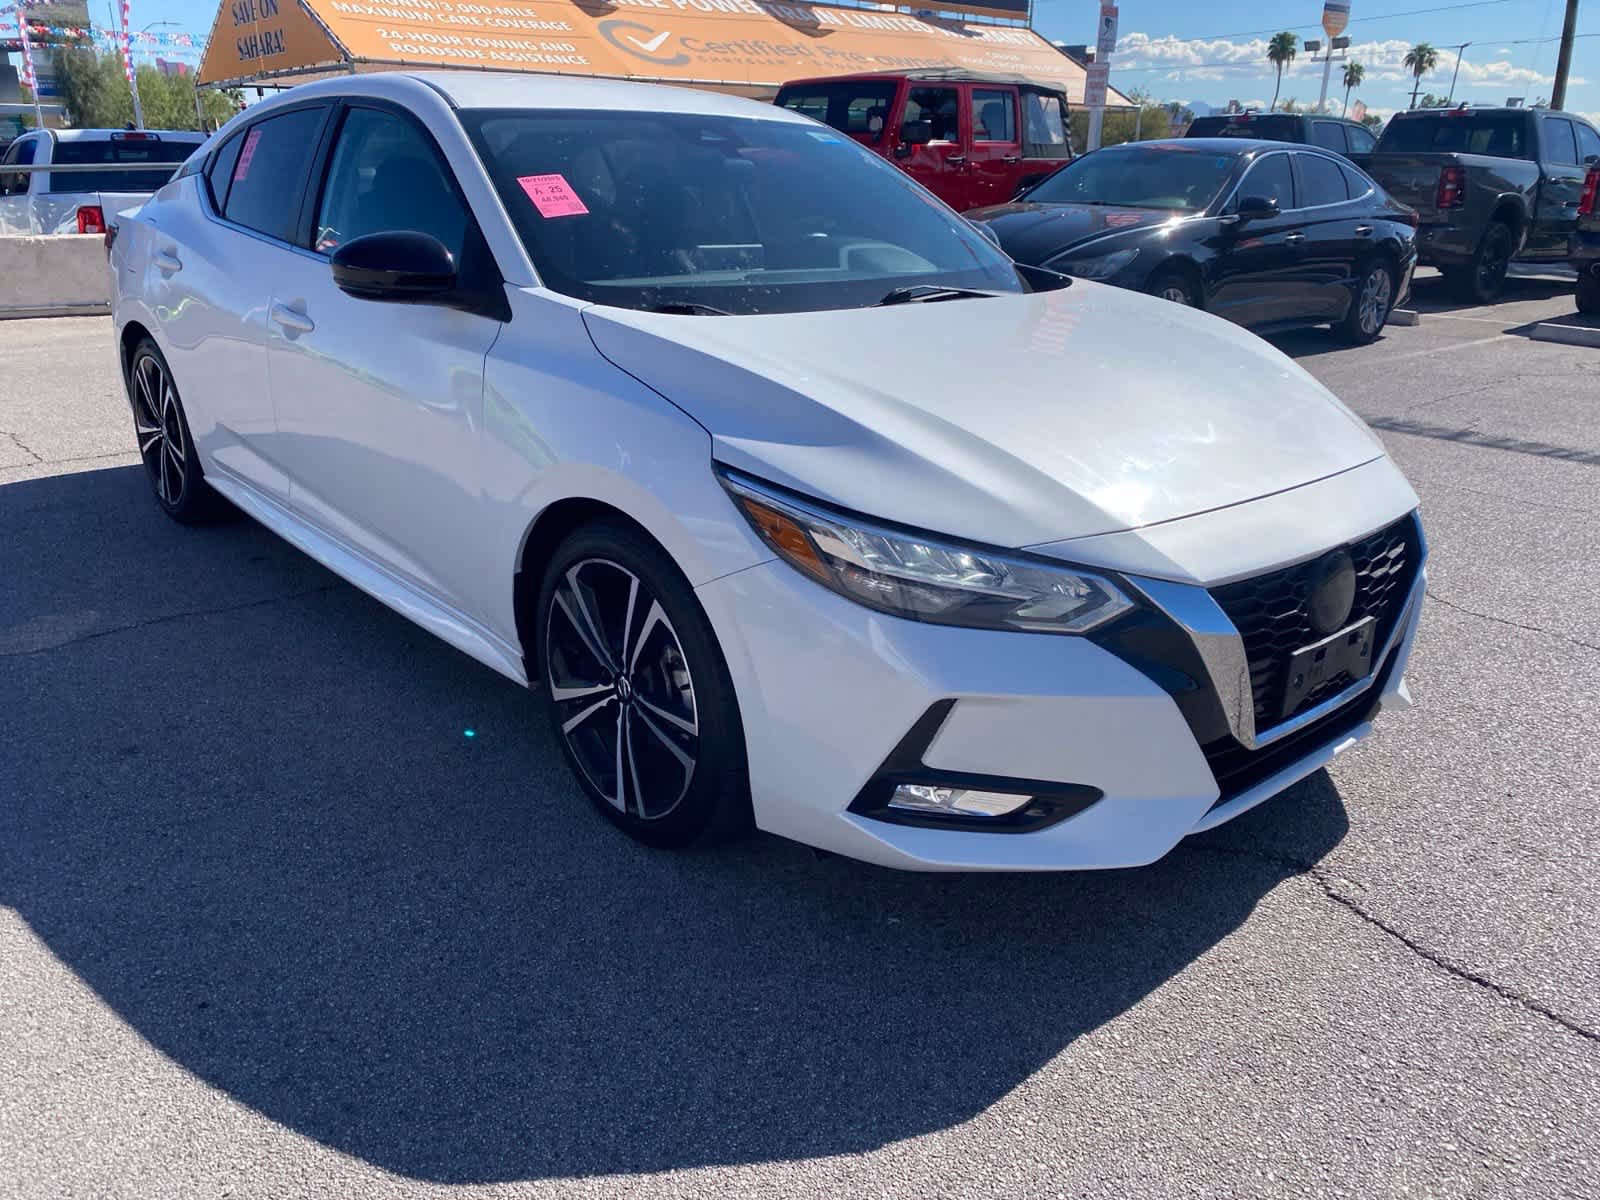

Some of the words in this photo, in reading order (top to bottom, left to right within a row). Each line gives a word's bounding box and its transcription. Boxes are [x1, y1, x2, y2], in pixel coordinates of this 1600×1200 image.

[232, 0, 257, 26] SAVE
[259, 0, 278, 19] ON
[331, 1, 434, 22] MAXIMUM
[436, 13, 484, 26] CARE
[485, 17, 573, 31] COVERAGE
[671, 0, 844, 26] POWERTRAIN
[840, 12, 935, 34] LIMITED
[237, 29, 285, 60] SAHARA!
[376, 28, 464, 46] 24-HOUR
[463, 37, 538, 50] TOWING
[540, 42, 577, 52] AND
[679, 37, 815, 56] Certified
[390, 43, 485, 59] ROADSIDE
[489, 50, 591, 65] ASSISTANCE
